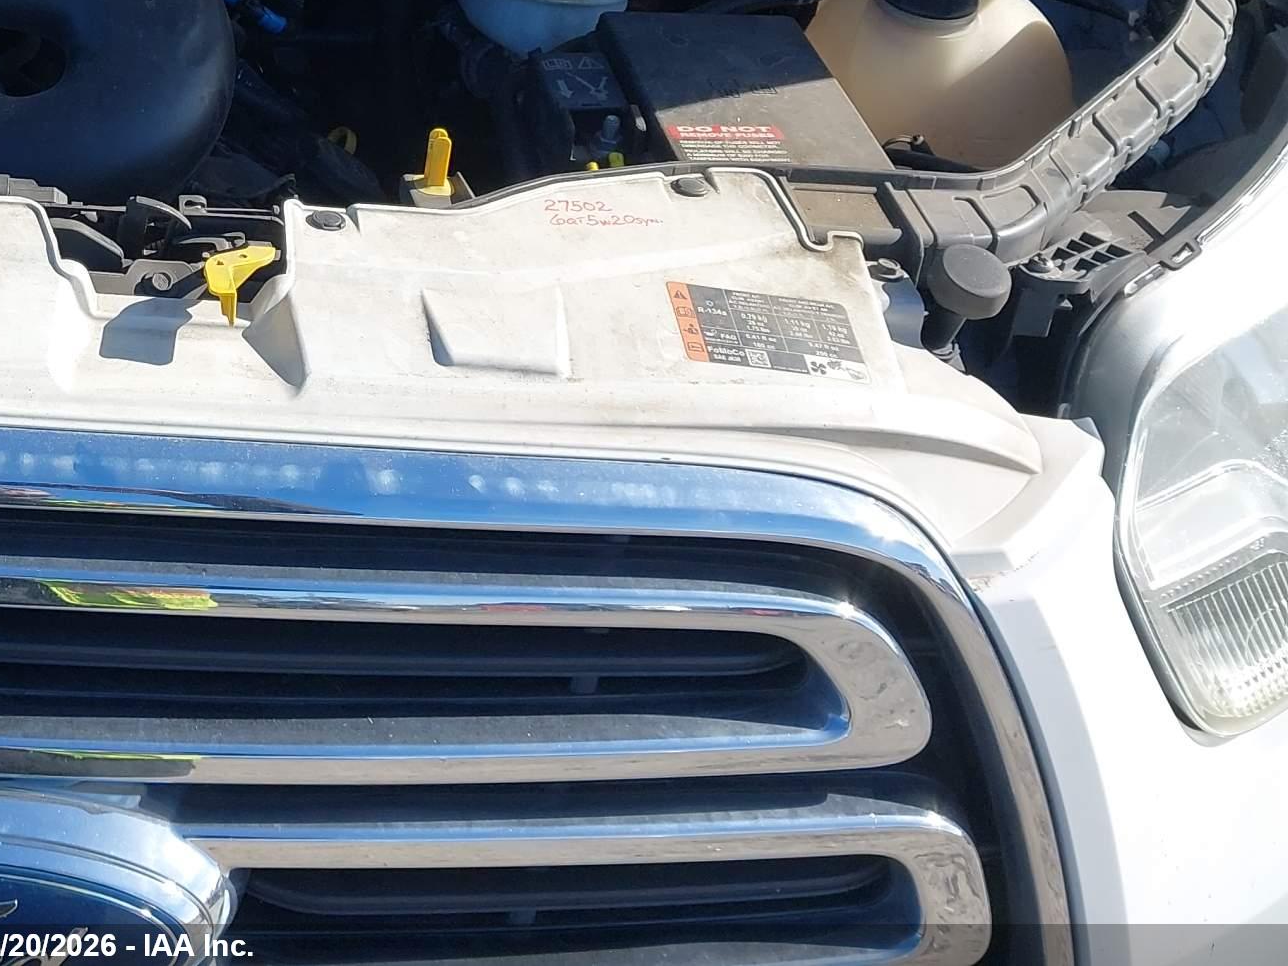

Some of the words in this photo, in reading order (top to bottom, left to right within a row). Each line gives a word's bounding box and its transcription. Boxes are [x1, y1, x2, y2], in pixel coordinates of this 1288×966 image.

[544, 199, 612, 212] 27502
[697, 306, 728, 316] R-134a
[707, 346, 745, 357] FoMoCo
